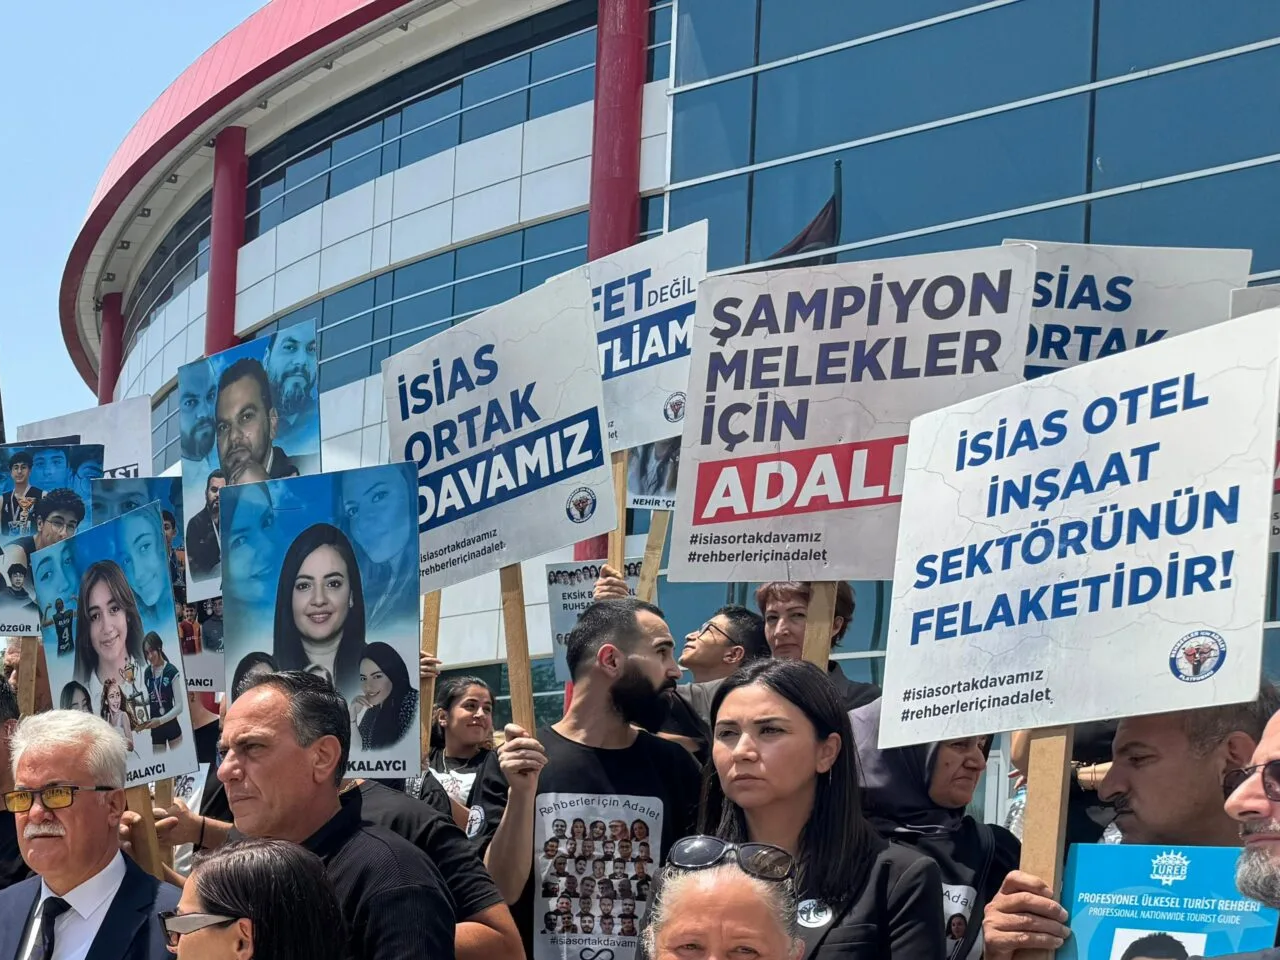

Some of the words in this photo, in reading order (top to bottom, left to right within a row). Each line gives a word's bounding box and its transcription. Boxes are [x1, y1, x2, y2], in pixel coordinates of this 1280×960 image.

[648, 276, 696, 308] DEĞİL
[710, 270, 1012, 347] ŞAMPİYON
[706, 329, 1002, 392] MELEKLER
[397, 343, 499, 421] İSİAS
[404, 381, 541, 469] ORTAK
[701, 392, 809, 452] İÇİN
[956, 410, 1068, 471] İSİAS
[1083, 373, 1209, 434] OTEL
[418, 419, 593, 525] DAVAMIZ
[986, 442, 1161, 518] İNŞAAT
[632, 498, 660, 506] NEHİR
[689, 531, 822, 546] #isiasortakdavamız
[913, 485, 1240, 589] SEKTÖRÜNÜN
[562, 590, 587, 600] EKSİK
[910, 551, 1234, 645] FELAKETİDİR!
[0, 623, 31, 632] ÖZGÜR
[903, 669, 1044, 702] #isiasortakdavamız
[347, 760, 407, 772] KALAYCI
[539, 797, 596, 817] Rehberler
[597, 796, 619, 807] için
[622, 799, 660, 820] Adalet
[1152, 864, 1188, 875] TUREB
[1078, 892, 1140, 906] PROFESYONEL
[1141, 894, 1181, 908] ÜLKESEL
[1183, 896, 1216, 911] TURİST
[1088, 907, 1139, 919] PROFESSIONAL
[1140, 910, 1185, 922] NATIONWIDE
[1186, 913, 1217, 924] TOURIST
[1217, 915, 1241, 925] GUIDE
